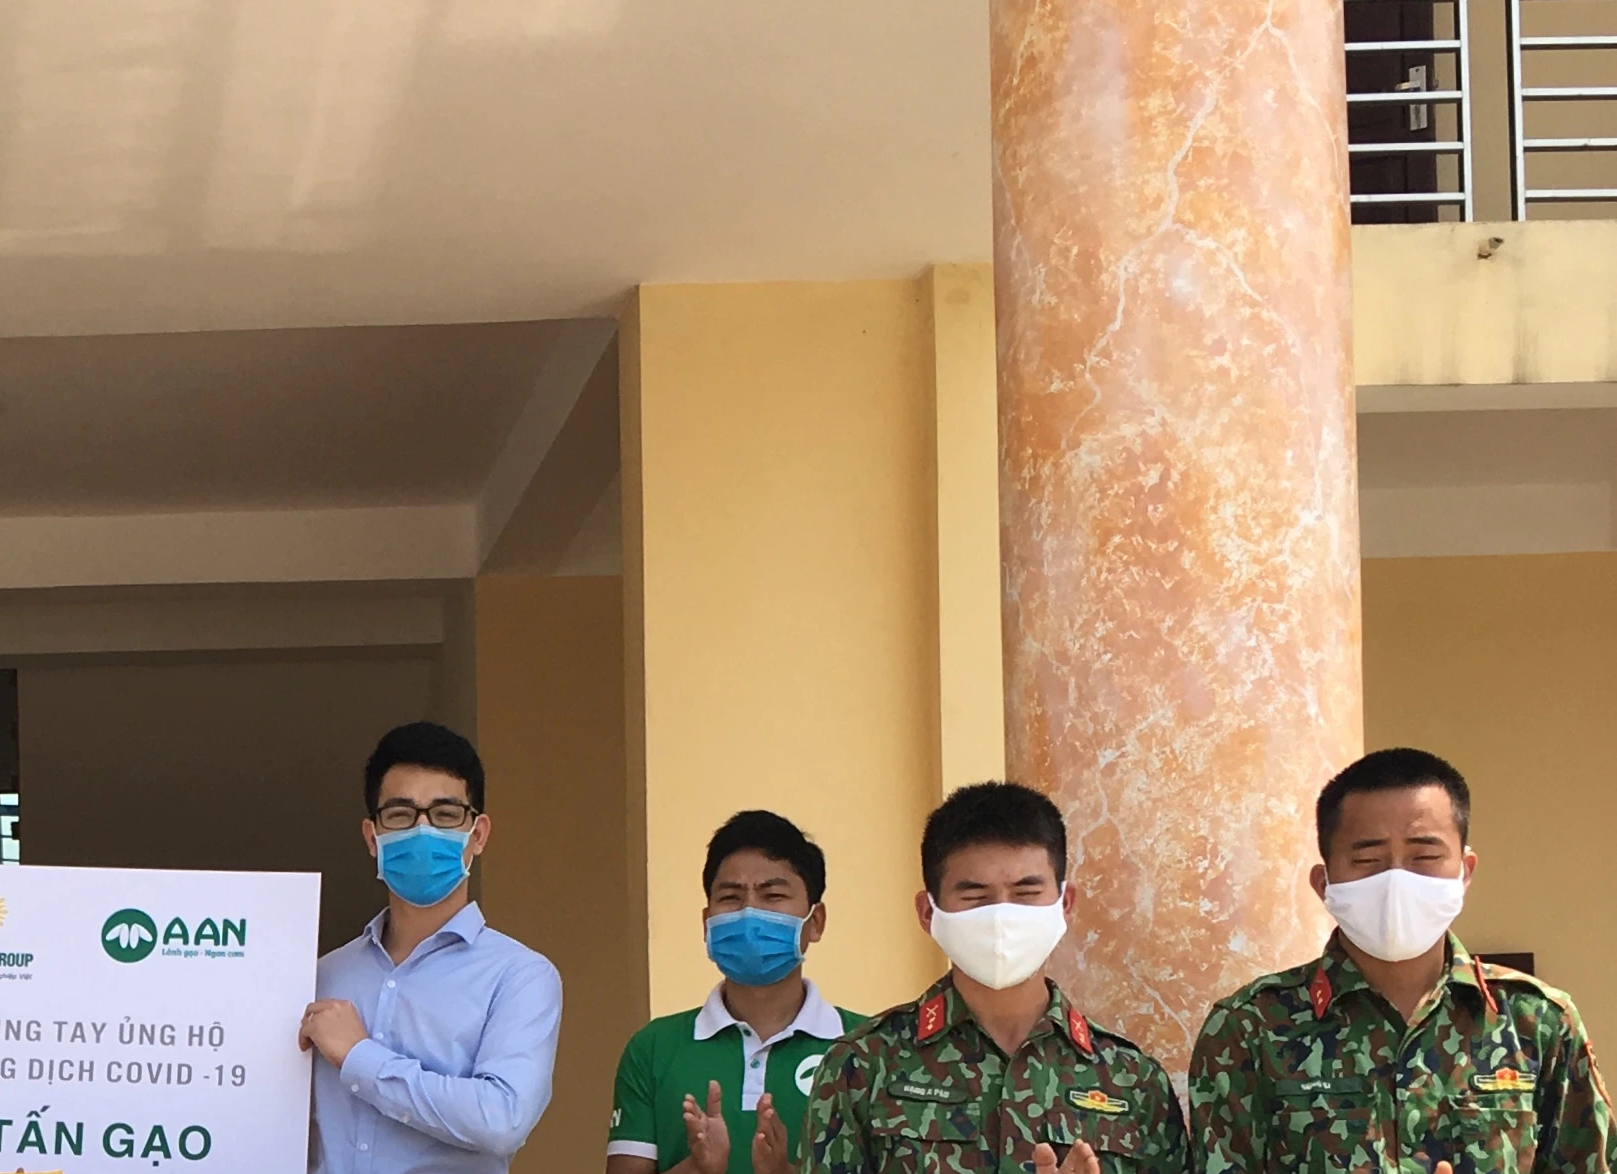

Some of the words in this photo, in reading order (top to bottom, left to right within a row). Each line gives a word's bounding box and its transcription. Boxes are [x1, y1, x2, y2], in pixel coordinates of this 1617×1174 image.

[53, 1021, 108, 1045] TAY
[118, 1016, 177, 1047] ỦNG
[187, 1021, 225, 1052] HỘ
[27, 1058, 95, 1086] DỊCH
[106, 1061, 193, 1086] COVID
[102, 1122, 213, 1167] GẠO
